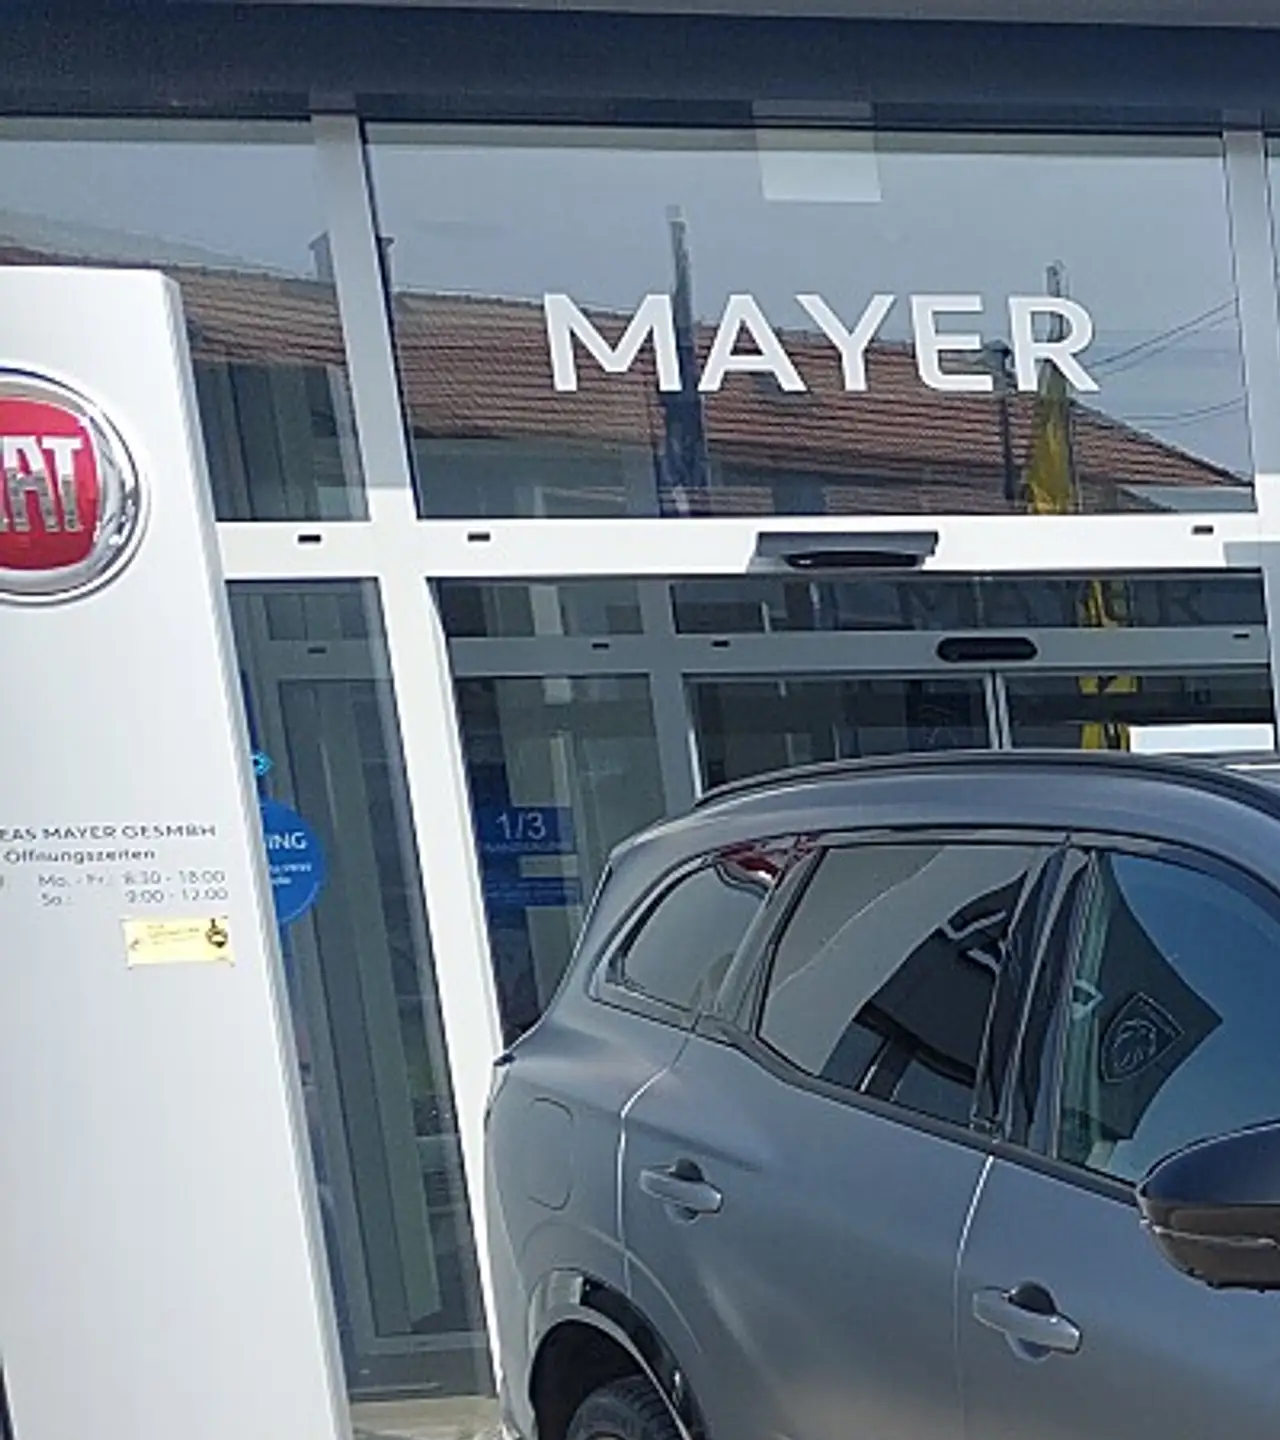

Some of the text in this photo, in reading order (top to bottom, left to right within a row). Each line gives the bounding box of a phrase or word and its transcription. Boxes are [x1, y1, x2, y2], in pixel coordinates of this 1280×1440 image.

[543, 294, 1099, 392] MAYER
[42, 825, 116, 839] MAYER
[496, 811, 547, 840] 1/3
